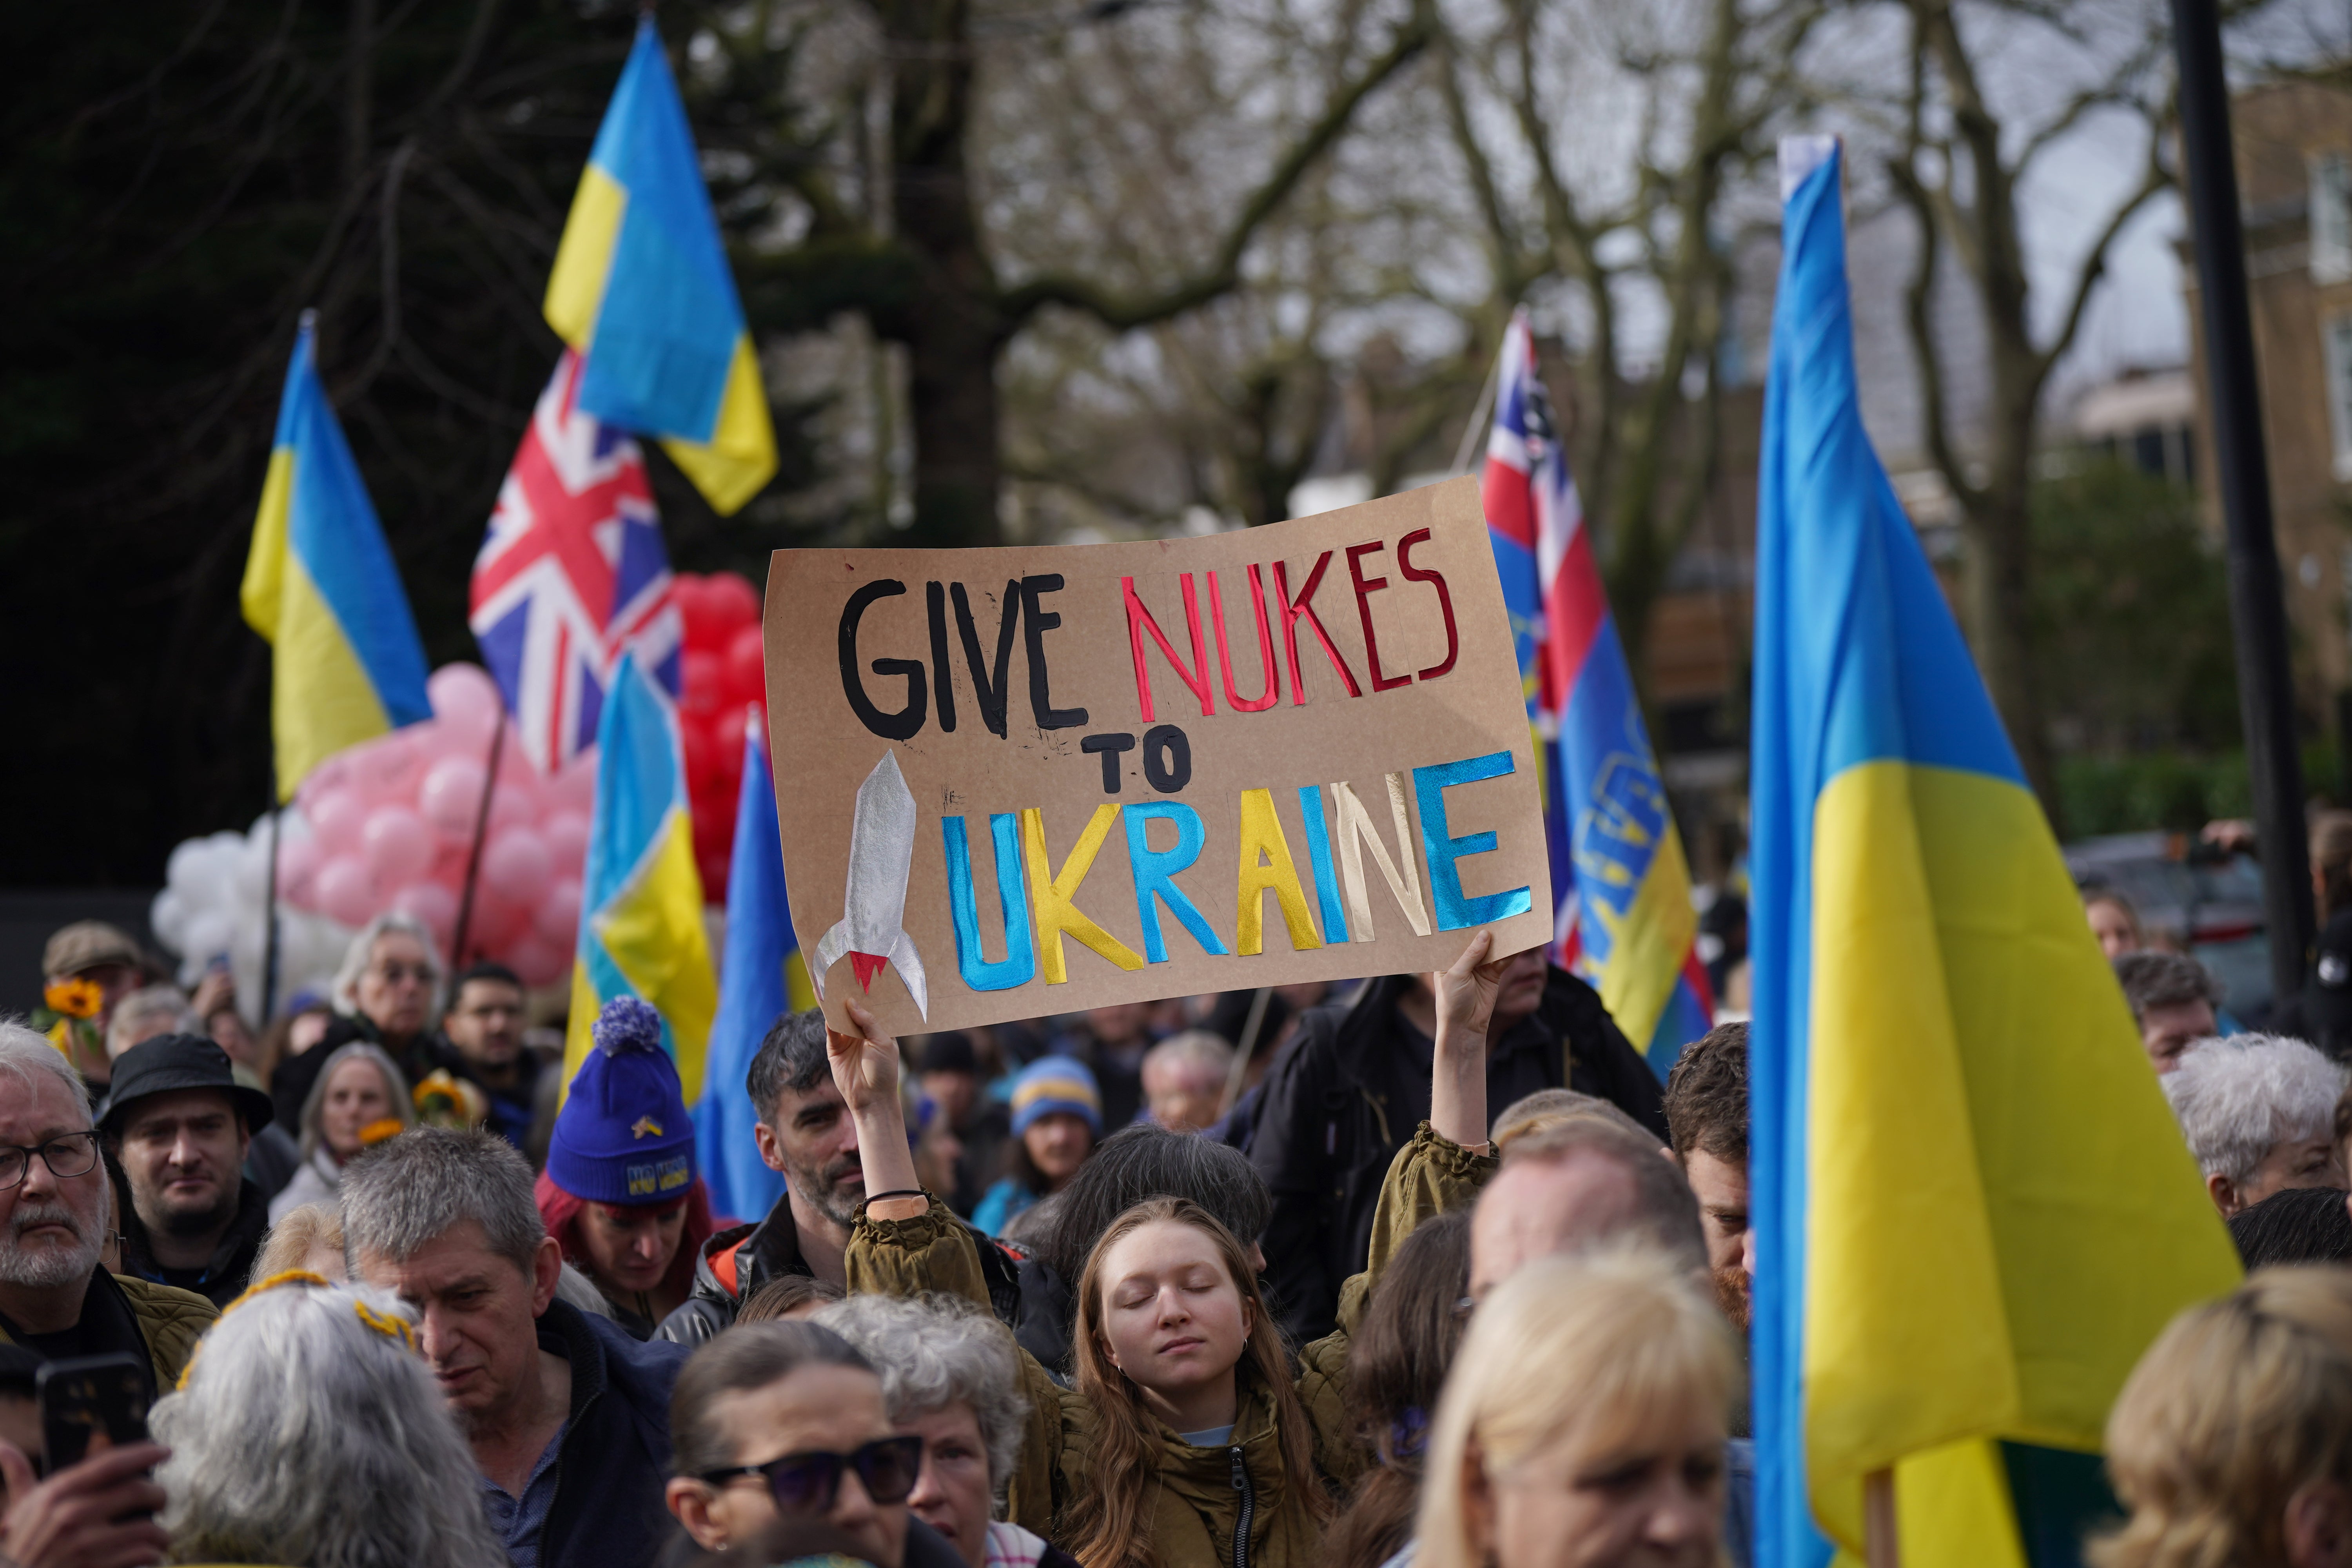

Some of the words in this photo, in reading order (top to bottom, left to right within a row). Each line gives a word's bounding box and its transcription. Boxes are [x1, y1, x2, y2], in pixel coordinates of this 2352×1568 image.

[838, 573, 1088, 740] GIVE
[1122, 527, 1459, 722] NUKES
[1081, 724, 1192, 794] TO
[942, 750, 1532, 991] UKRAINE
[628, 1164, 655, 1195] NO
